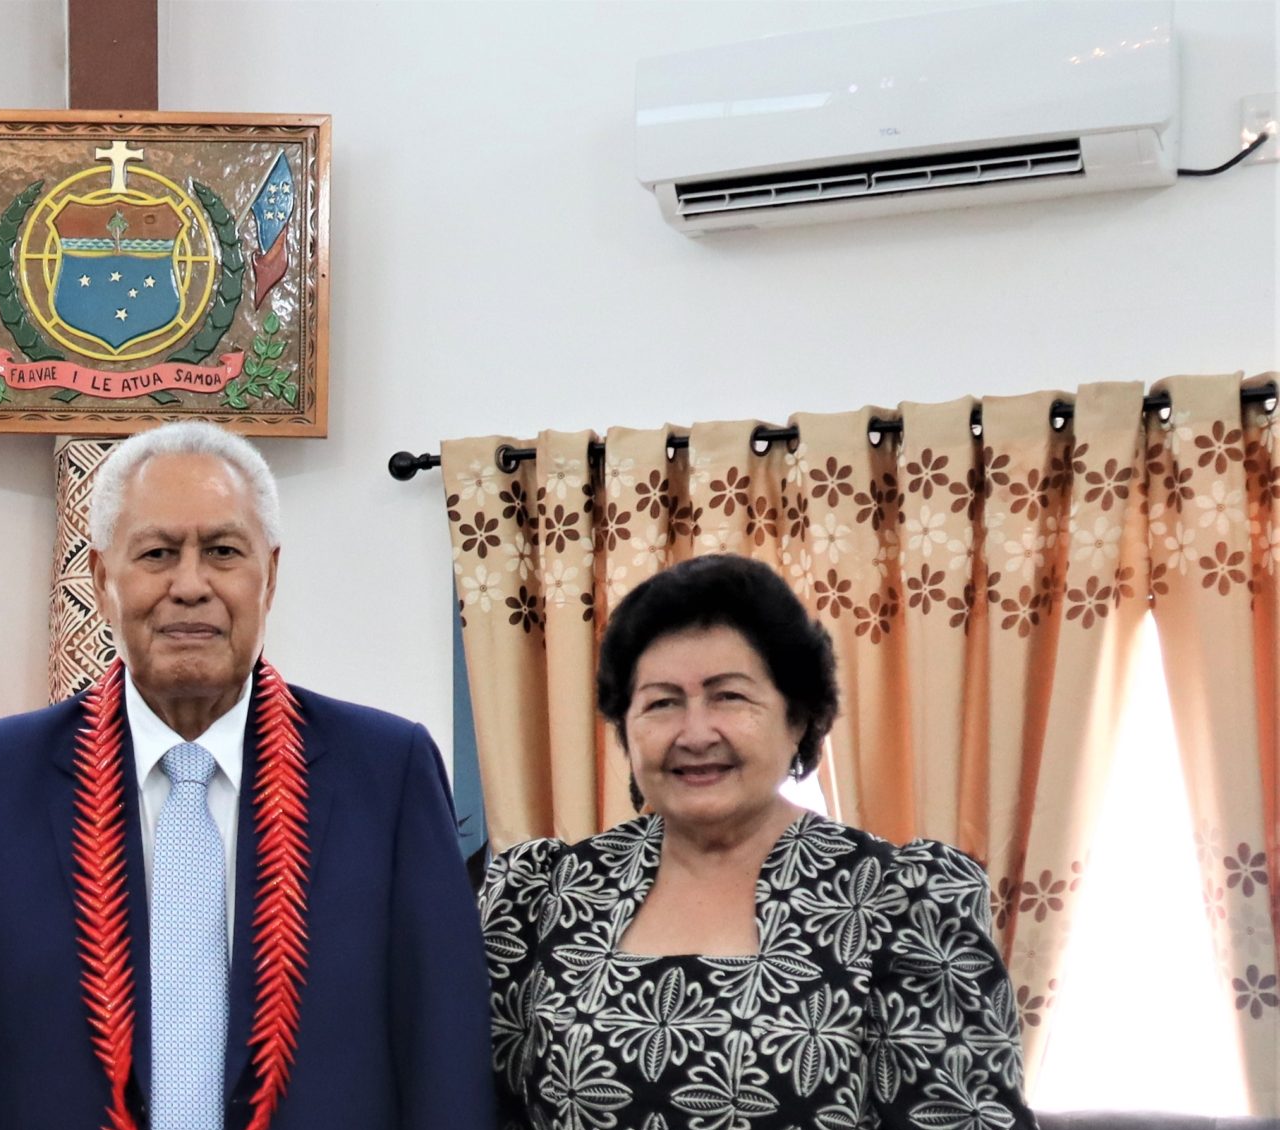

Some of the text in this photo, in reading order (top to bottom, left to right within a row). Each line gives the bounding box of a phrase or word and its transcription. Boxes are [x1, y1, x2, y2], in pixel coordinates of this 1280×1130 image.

[879, 127, 902, 137] TCL
[72, 371, 78, 383] I
[91, 376, 112, 392] LE
[121, 372, 163, 392] ATUA
[174, 368, 222, 386] SAMOA
